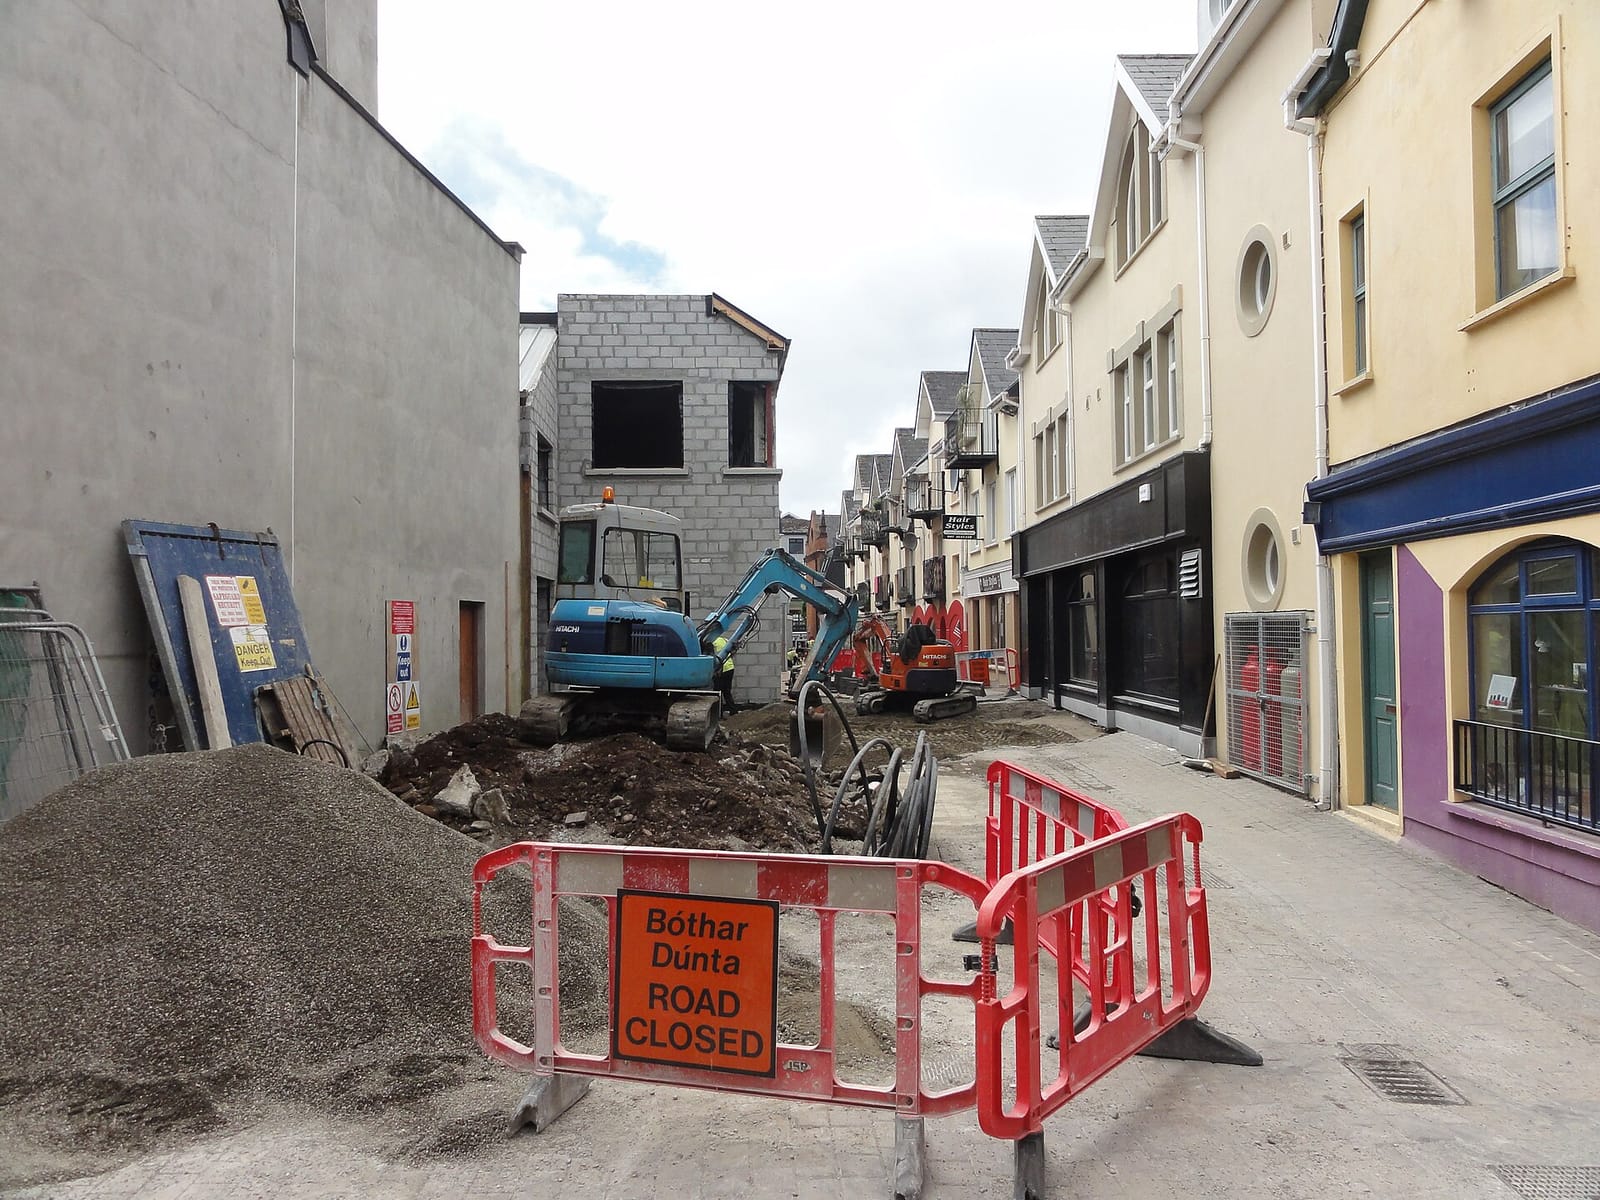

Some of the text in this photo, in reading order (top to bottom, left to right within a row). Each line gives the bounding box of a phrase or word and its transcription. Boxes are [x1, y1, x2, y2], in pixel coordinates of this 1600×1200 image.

[945, 522, 975, 530] Styles
[236, 644, 269, 656] DANGER
[398, 656, 410, 667] Keep
[240, 657, 257, 667] Keep
[646, 908, 749, 942] Bóthar
[652, 941, 741, 976] Dúnta
[648, 982, 741, 1019] ROAD
[625, 1016, 764, 1059] CLOSED
